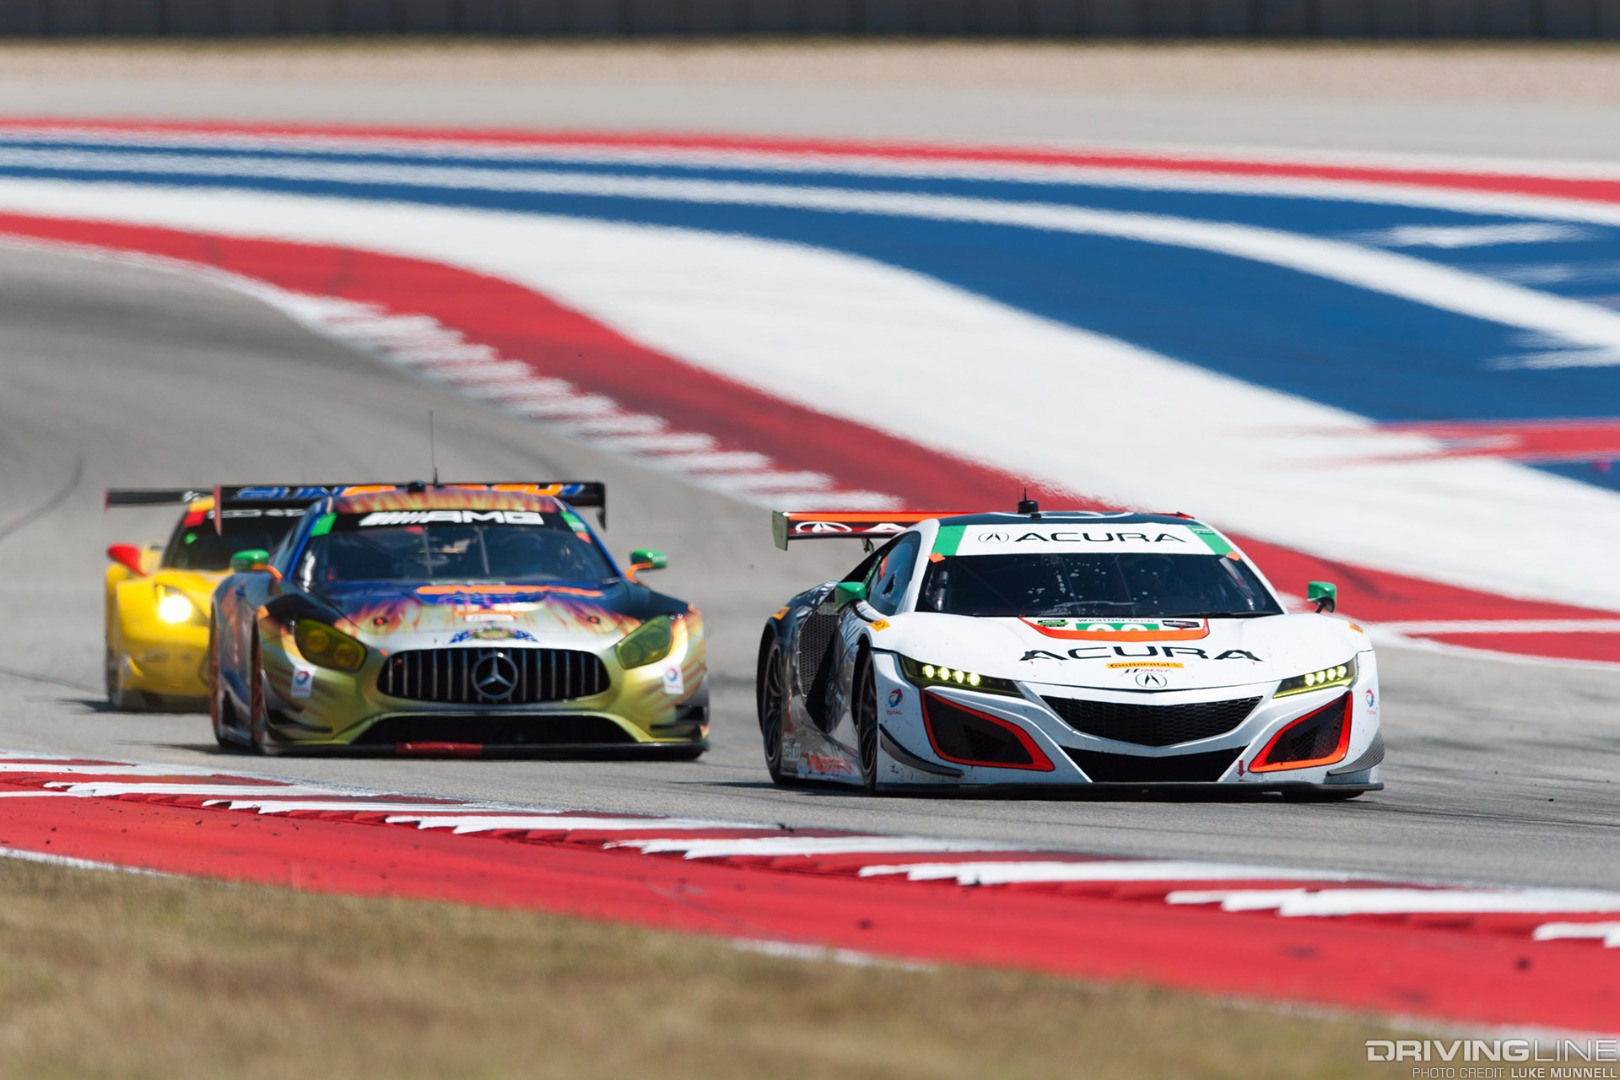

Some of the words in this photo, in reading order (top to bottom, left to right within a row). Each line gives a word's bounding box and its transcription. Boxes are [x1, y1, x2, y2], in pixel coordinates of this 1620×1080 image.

[418, 510, 545, 525] AMG
[1014, 532, 1187, 543] ACURA
[1019, 646, 1263, 662] ACURA
